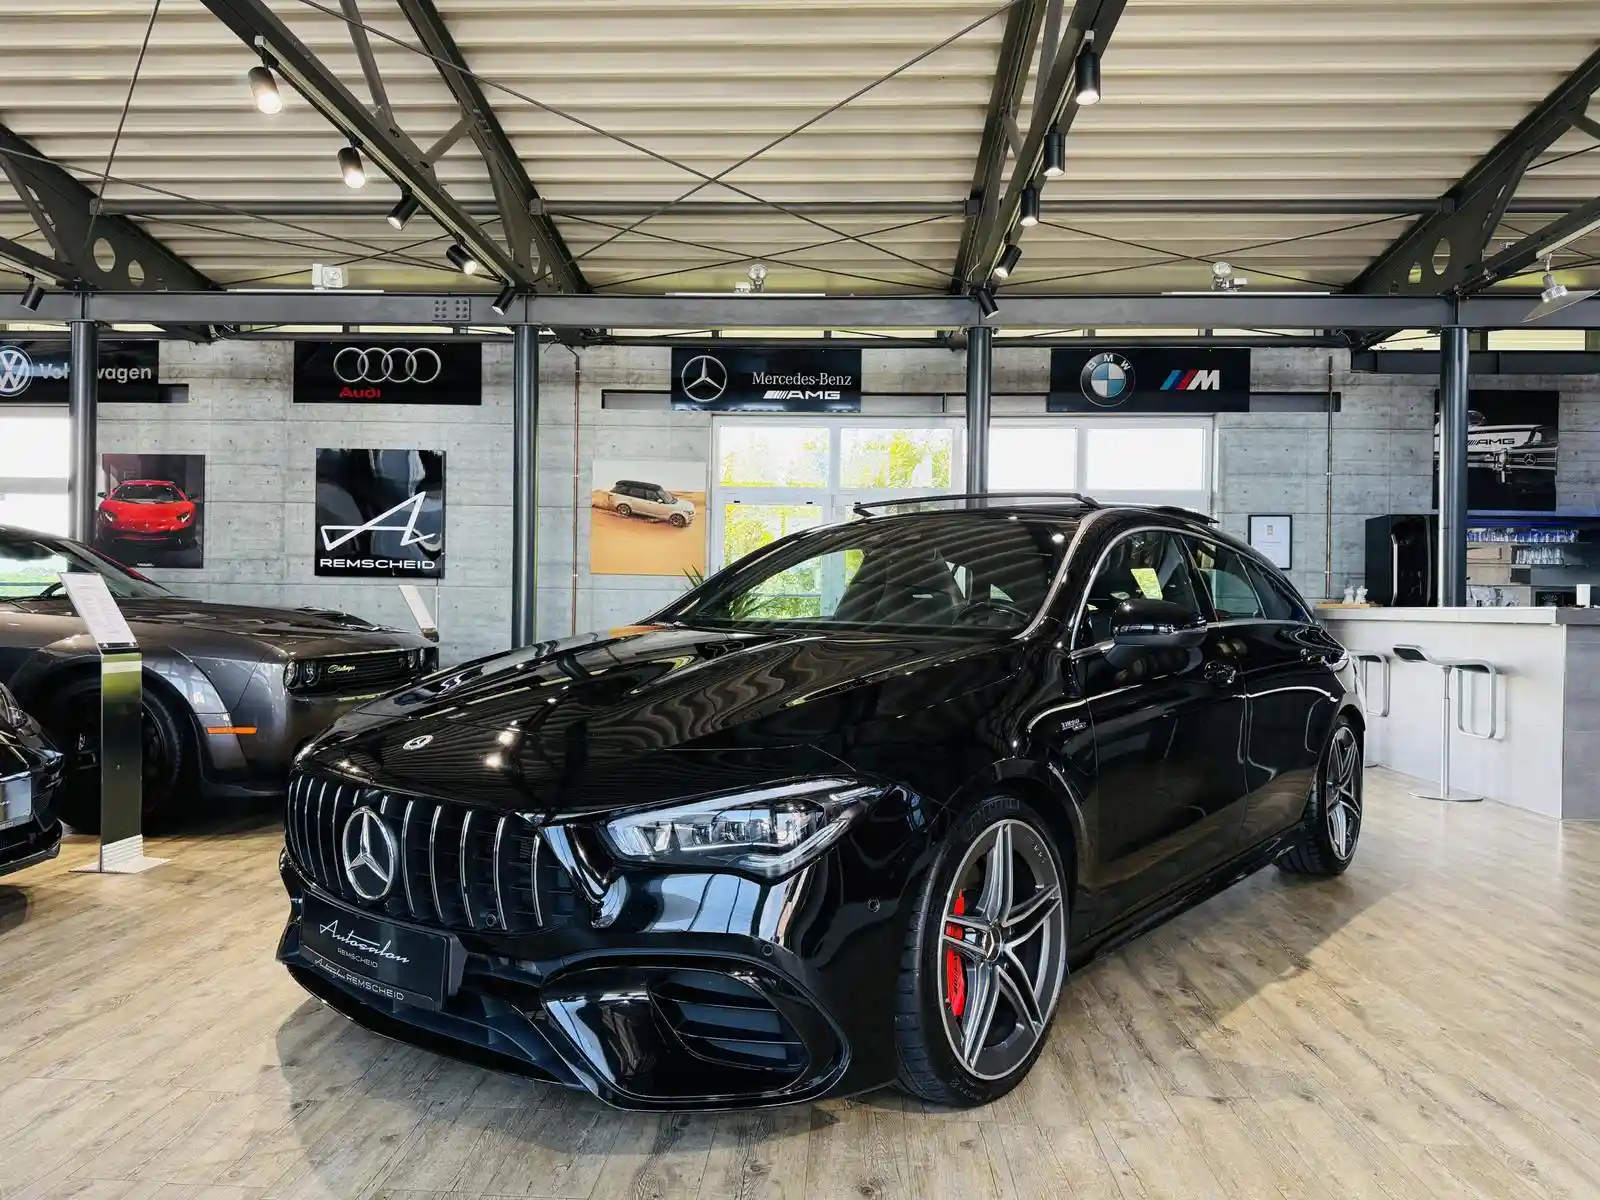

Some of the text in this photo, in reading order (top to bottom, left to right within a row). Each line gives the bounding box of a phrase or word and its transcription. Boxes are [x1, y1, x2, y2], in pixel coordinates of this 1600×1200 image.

[752, 372, 852, 386] Mercedes-Benz
[339, 386, 381, 399] Audi
[319, 558, 436, 570] REMSCHEID
[319, 919, 410, 963] Autosalon
[337, 947, 379, 968] REMSCHEID
[346, 973, 405, 1001] REMSCHEID
